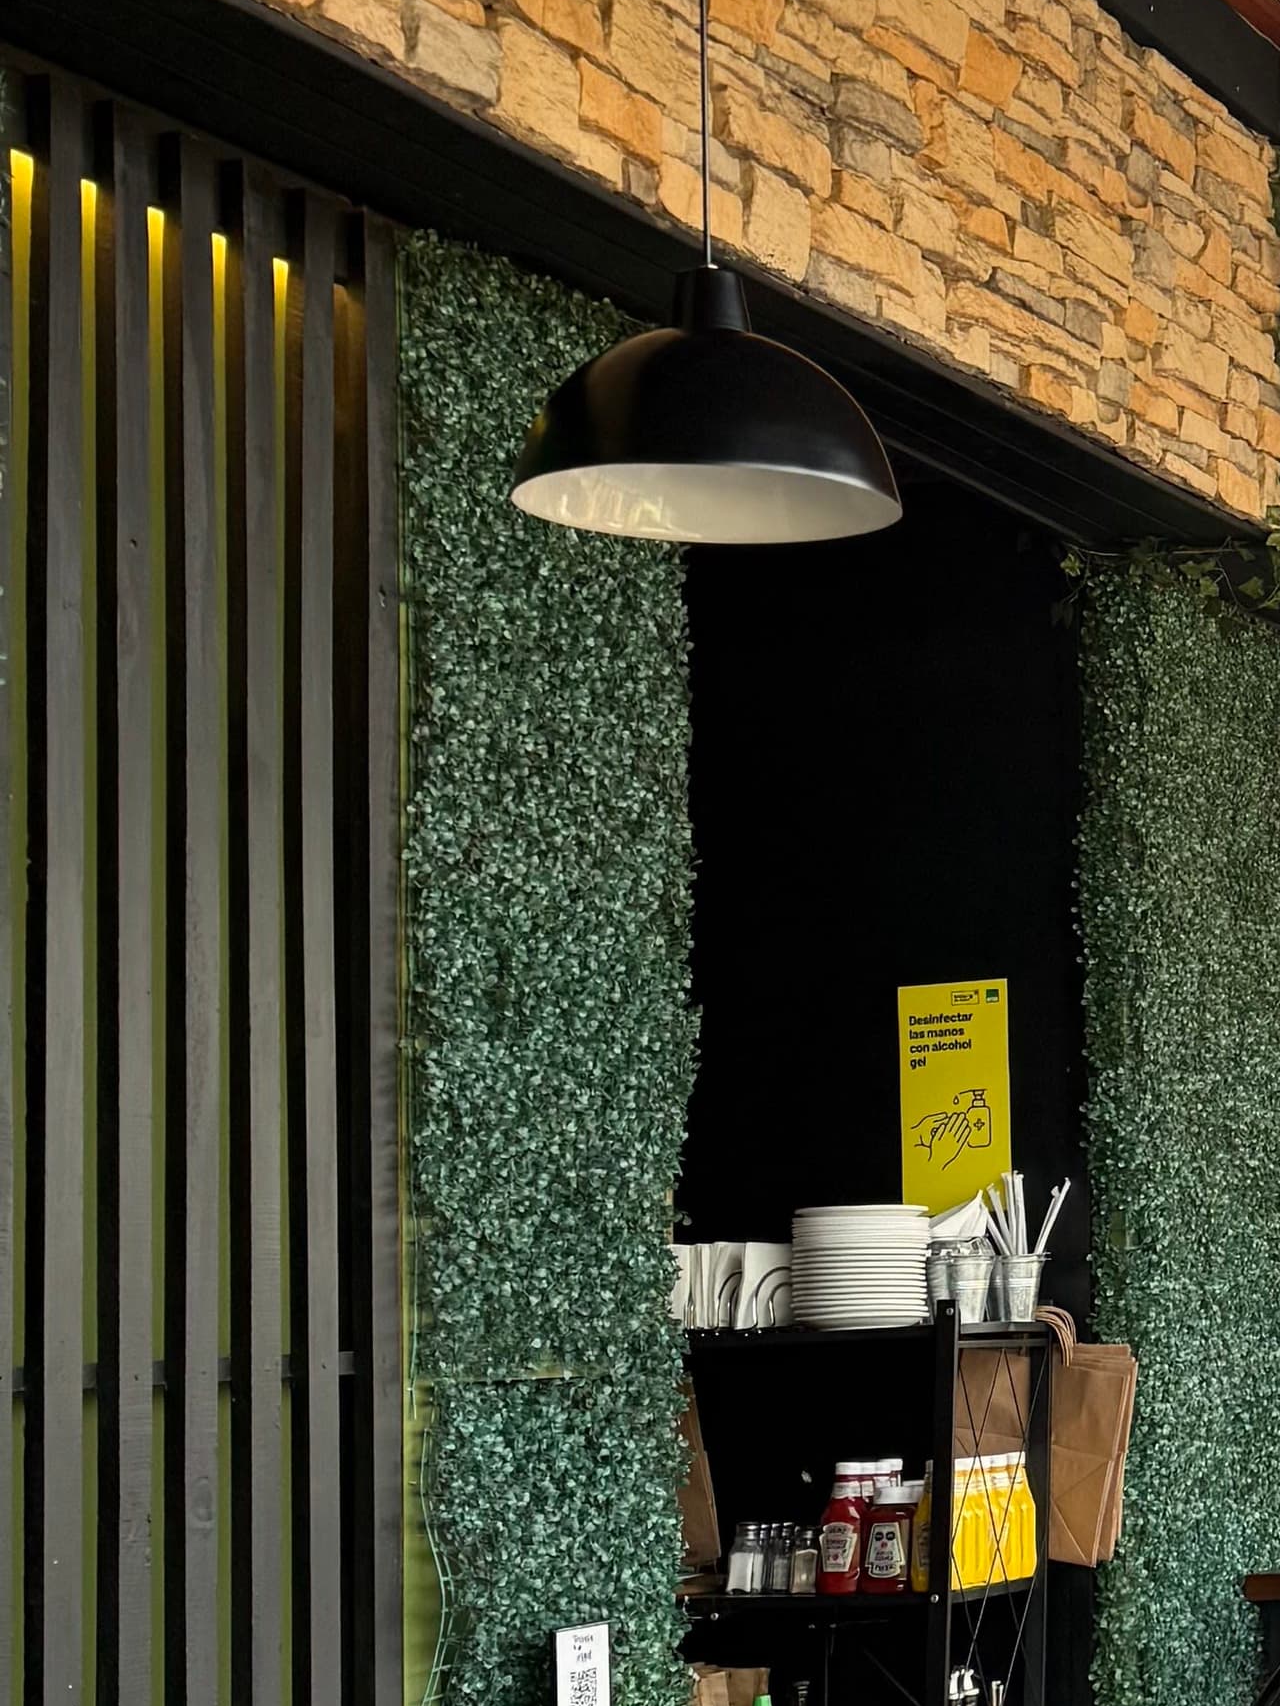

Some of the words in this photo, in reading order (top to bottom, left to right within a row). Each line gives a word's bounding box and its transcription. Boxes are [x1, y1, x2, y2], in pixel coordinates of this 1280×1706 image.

[908, 1012, 974, 1027] Desinfectar
[909, 1028, 926, 1041] las
[927, 1027, 966, 1039] manos
[909, 1043, 930, 1054] con
[931, 1038, 972, 1052] alcohol
[909, 1055, 927, 1071] gel
